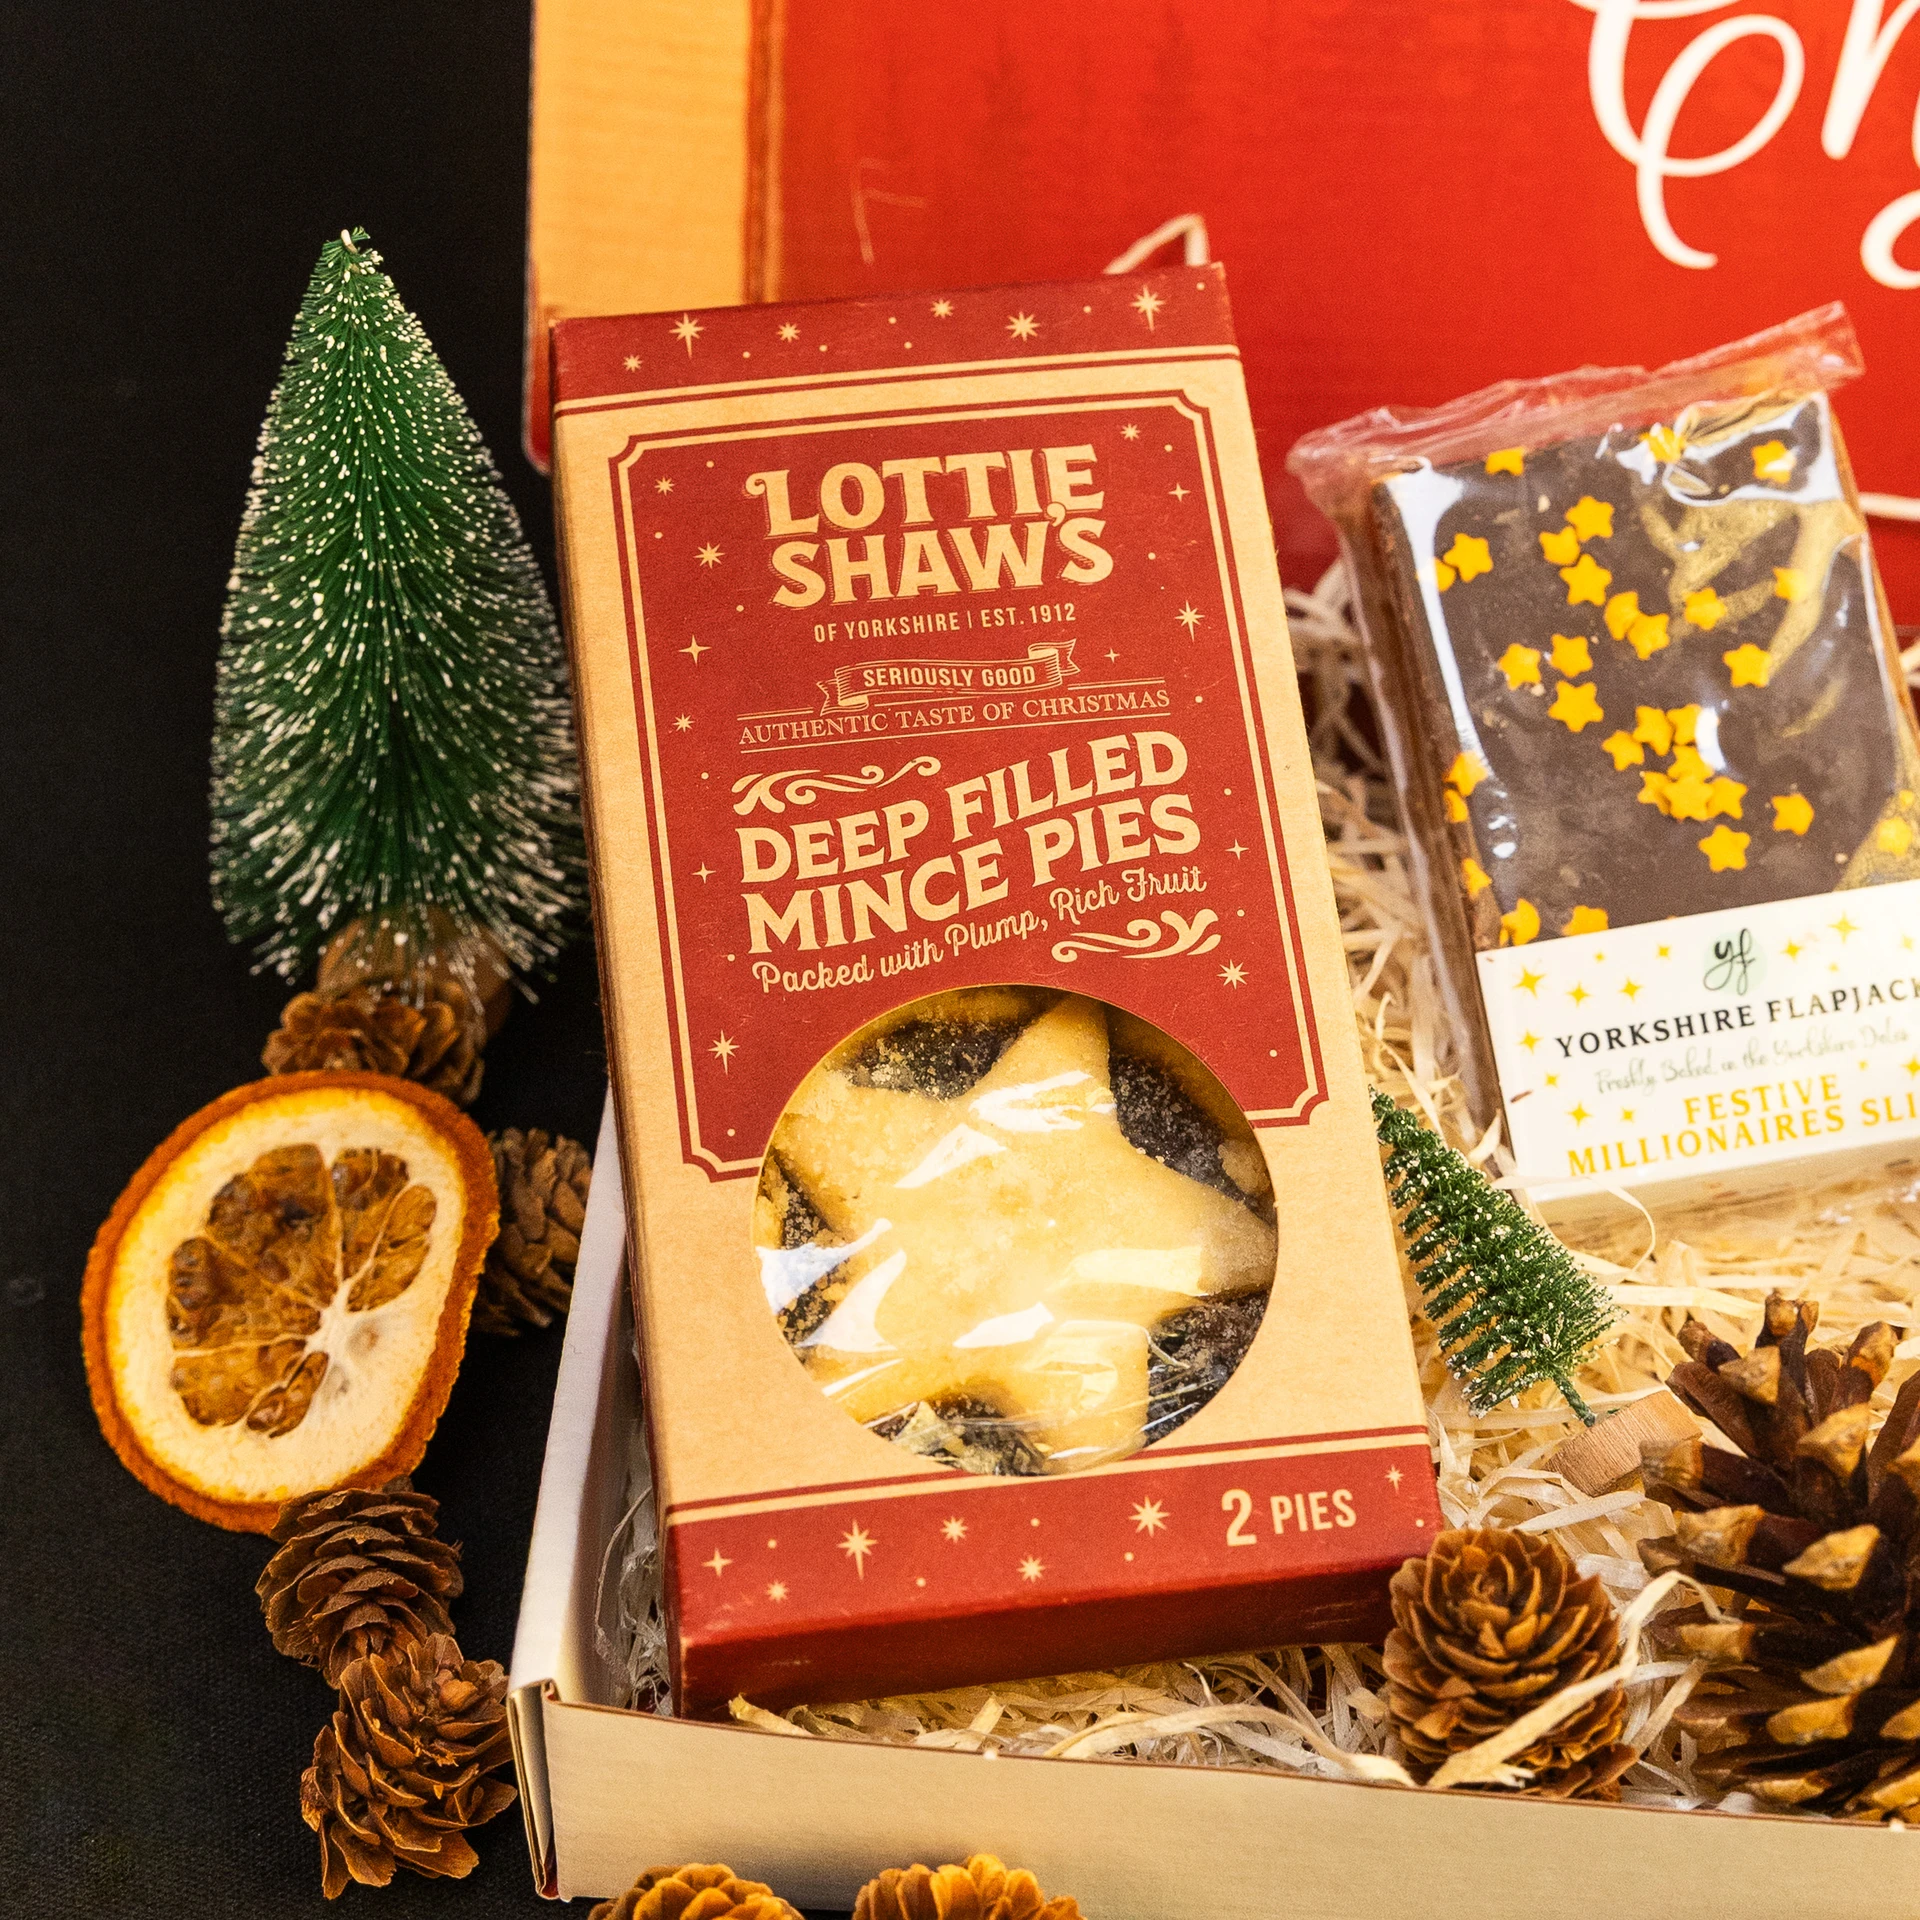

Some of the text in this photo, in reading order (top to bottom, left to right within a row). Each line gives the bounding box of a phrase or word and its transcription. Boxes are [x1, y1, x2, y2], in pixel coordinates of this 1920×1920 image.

[745, 443, 1105, 539] LOTTIE
[768, 501, 1114, 610] SHAW'S
[814, 603, 1077, 643] OF YORKSHIRE EST. 1912
[863, 666, 1036, 688] SERIOUSLY GOOD
[739, 690, 1171, 746] AUTHENTIC TASTE OF CHRISTMAS
[735, 731, 1189, 884] DEEP FILLED
[741, 793, 1202, 955] MINCE PIES
[751, 865, 1207, 993] Packed with Plump, Rich Fruit
[1554, 1005, 1757, 1058] YORKSHIRE
[1568, 1091, 1918, 1178] MILLIONAIRES SLI
[1684, 1073, 1842, 1126] FESTIVE
[1220, 1488, 1357, 1547] 2 PIES
